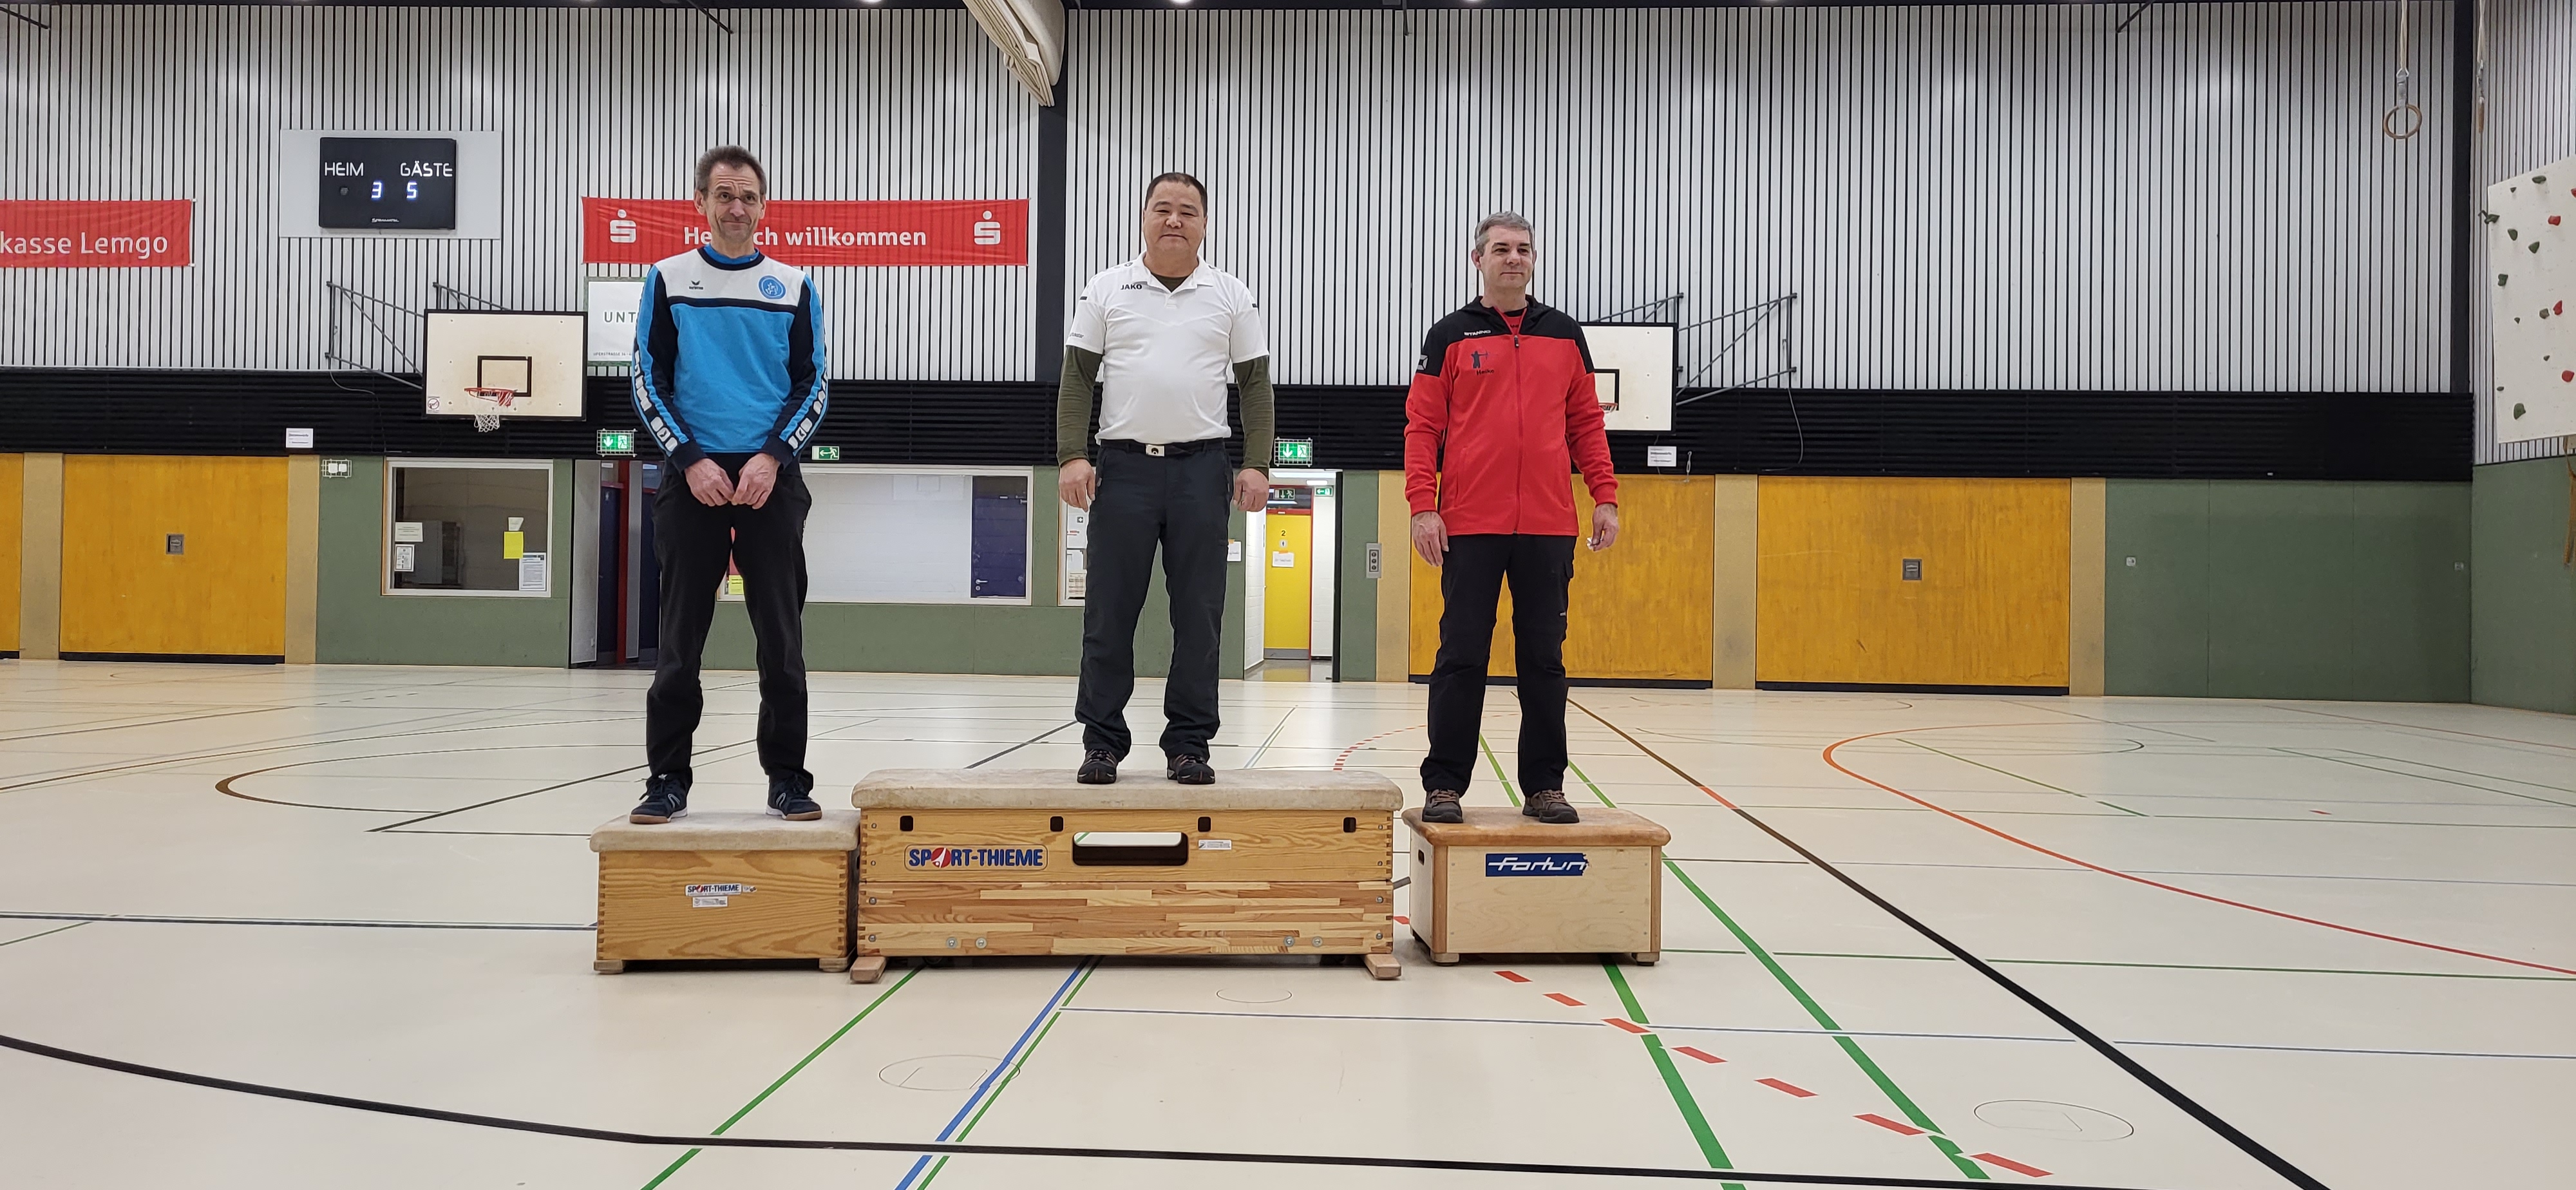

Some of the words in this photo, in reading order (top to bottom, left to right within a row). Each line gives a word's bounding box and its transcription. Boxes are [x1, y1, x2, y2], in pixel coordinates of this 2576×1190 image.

[324, 162, 365, 176] HEIM
[399, 160, 453, 177] GÄSTE
[371, 181, 383, 199] 3
[406, 181, 418, 199] 5
[0, 231, 71, 254] kasse
[80, 232, 167, 260] Lemgo
[785, 226, 926, 246] willkommen
